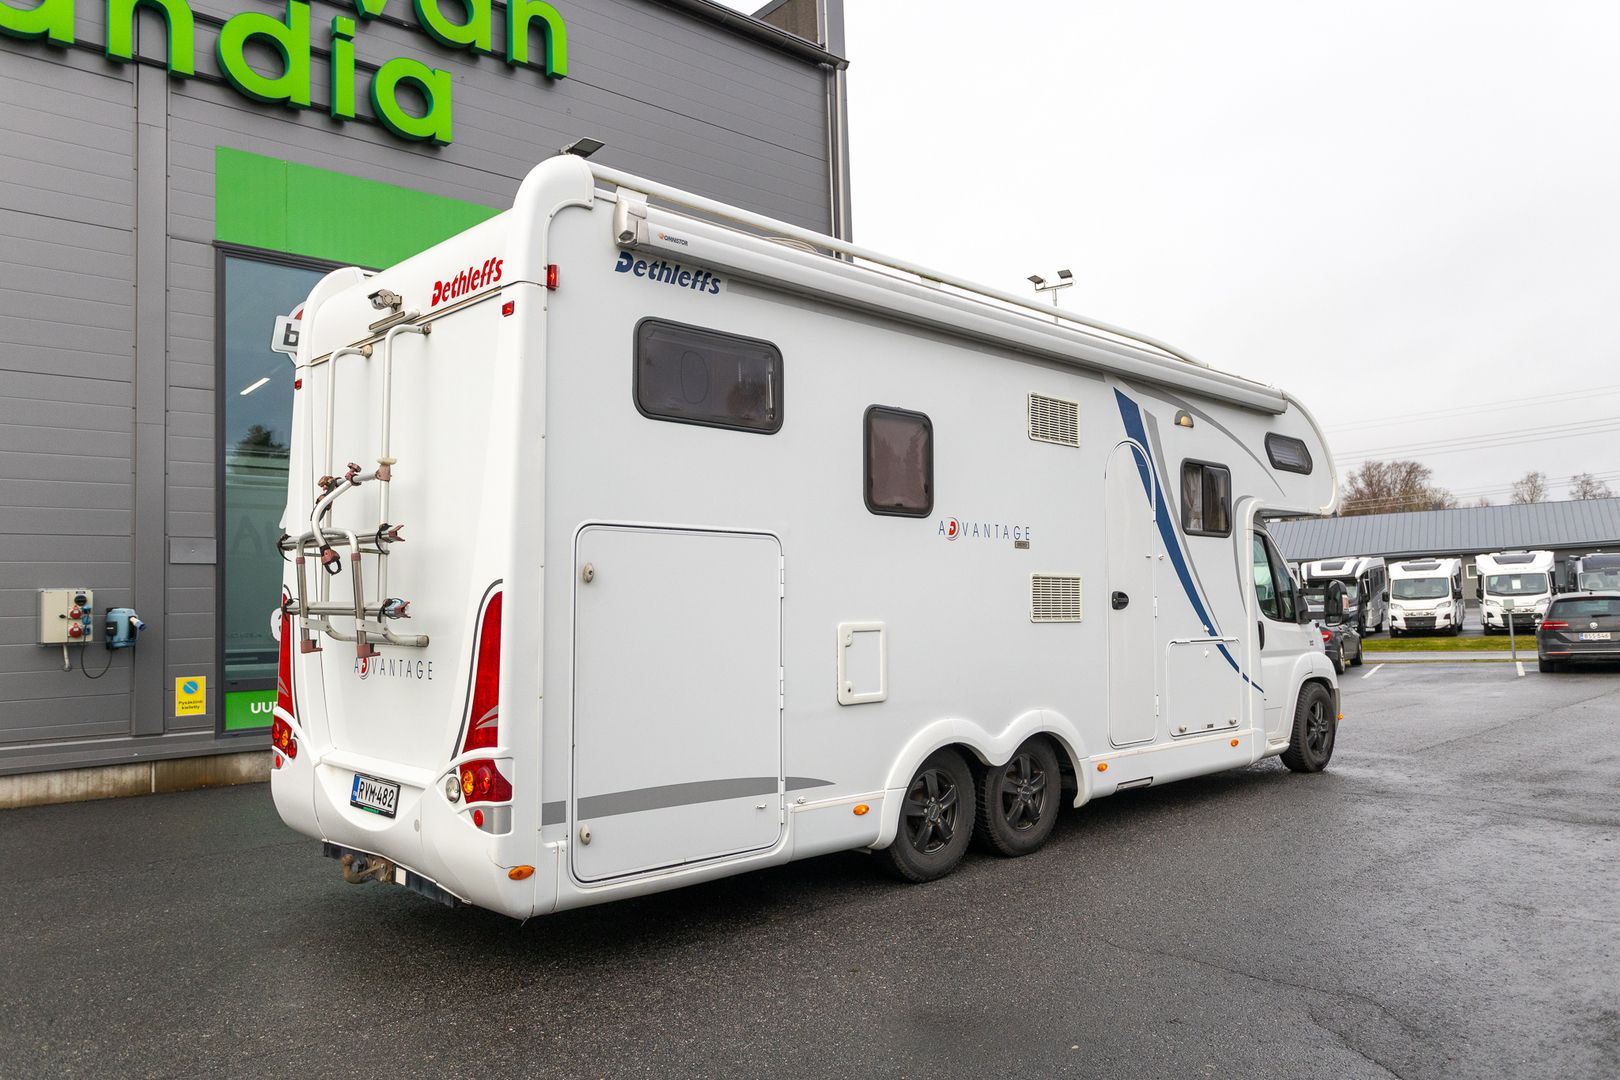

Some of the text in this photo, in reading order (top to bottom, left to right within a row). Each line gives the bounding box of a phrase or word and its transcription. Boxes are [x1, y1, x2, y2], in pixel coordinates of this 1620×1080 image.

[355, 0, 567, 80] an
[431, 257, 504, 307] Dethleffs
[614, 251, 721, 294] Dethleffs
[938, 516, 1030, 541] ADVANTAGE
[354, 657, 433, 680] ADVANTAGE
[358, 781, 395, 808] RVM-482
